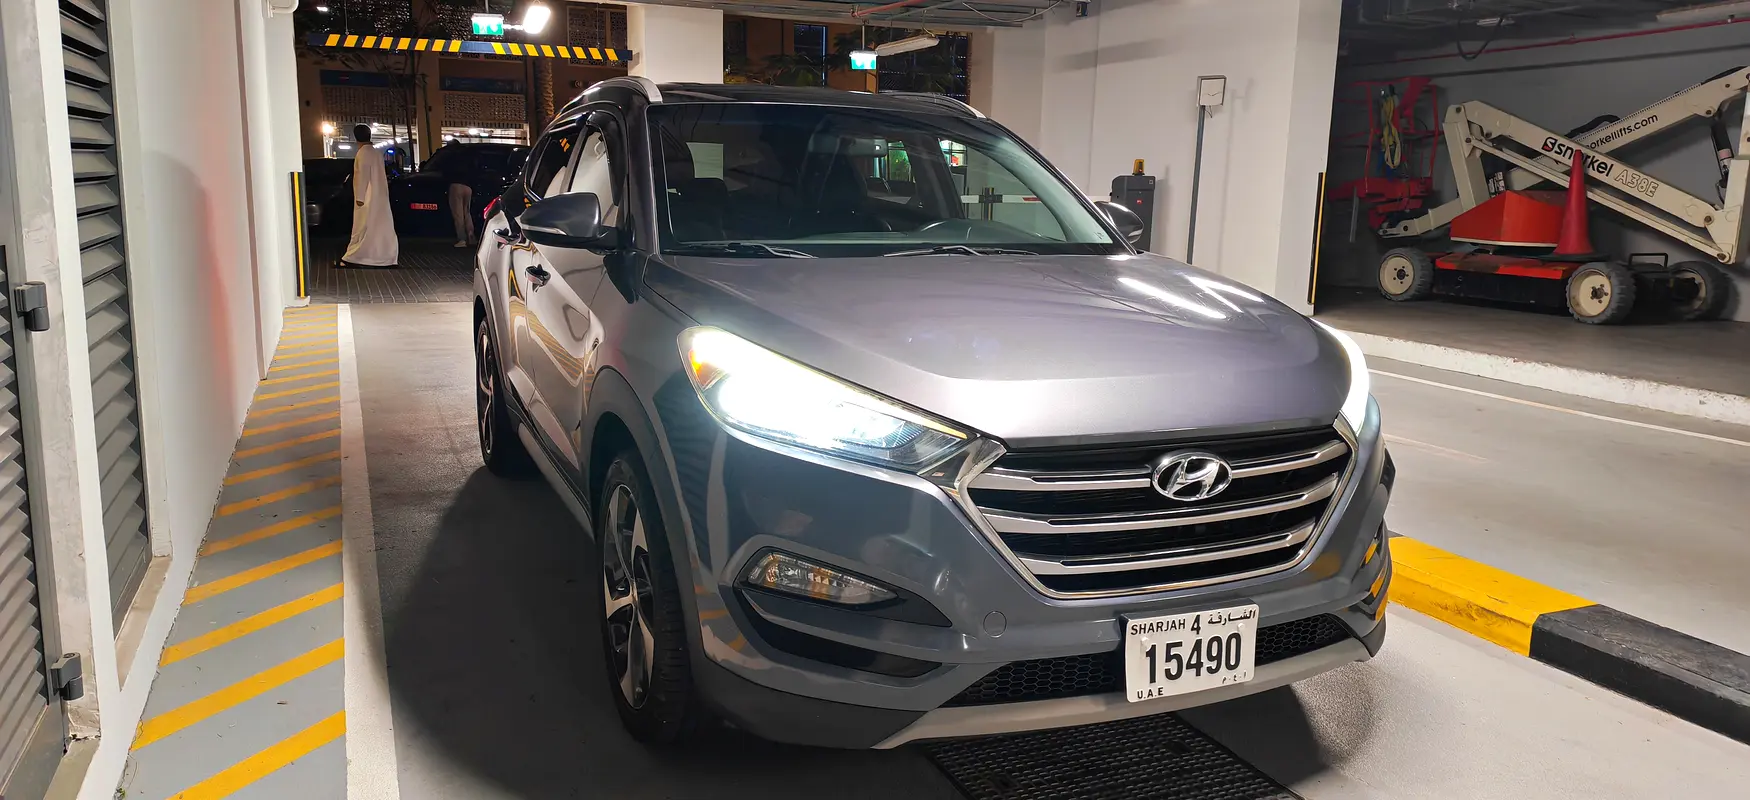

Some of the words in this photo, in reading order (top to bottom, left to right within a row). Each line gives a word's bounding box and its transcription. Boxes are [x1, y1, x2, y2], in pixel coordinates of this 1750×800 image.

[1554, 141, 1614, 177] snrkel
[1614, 168, 1659, 198] A38E
[1131, 618, 1185, 636] SHARJAH
[1190, 614, 1201, 635] 4
[1208, 608, 1257, 626] الشارقة
[1145, 632, 1242, 684] 15490
[1137, 686, 1164, 700] U.A.E
